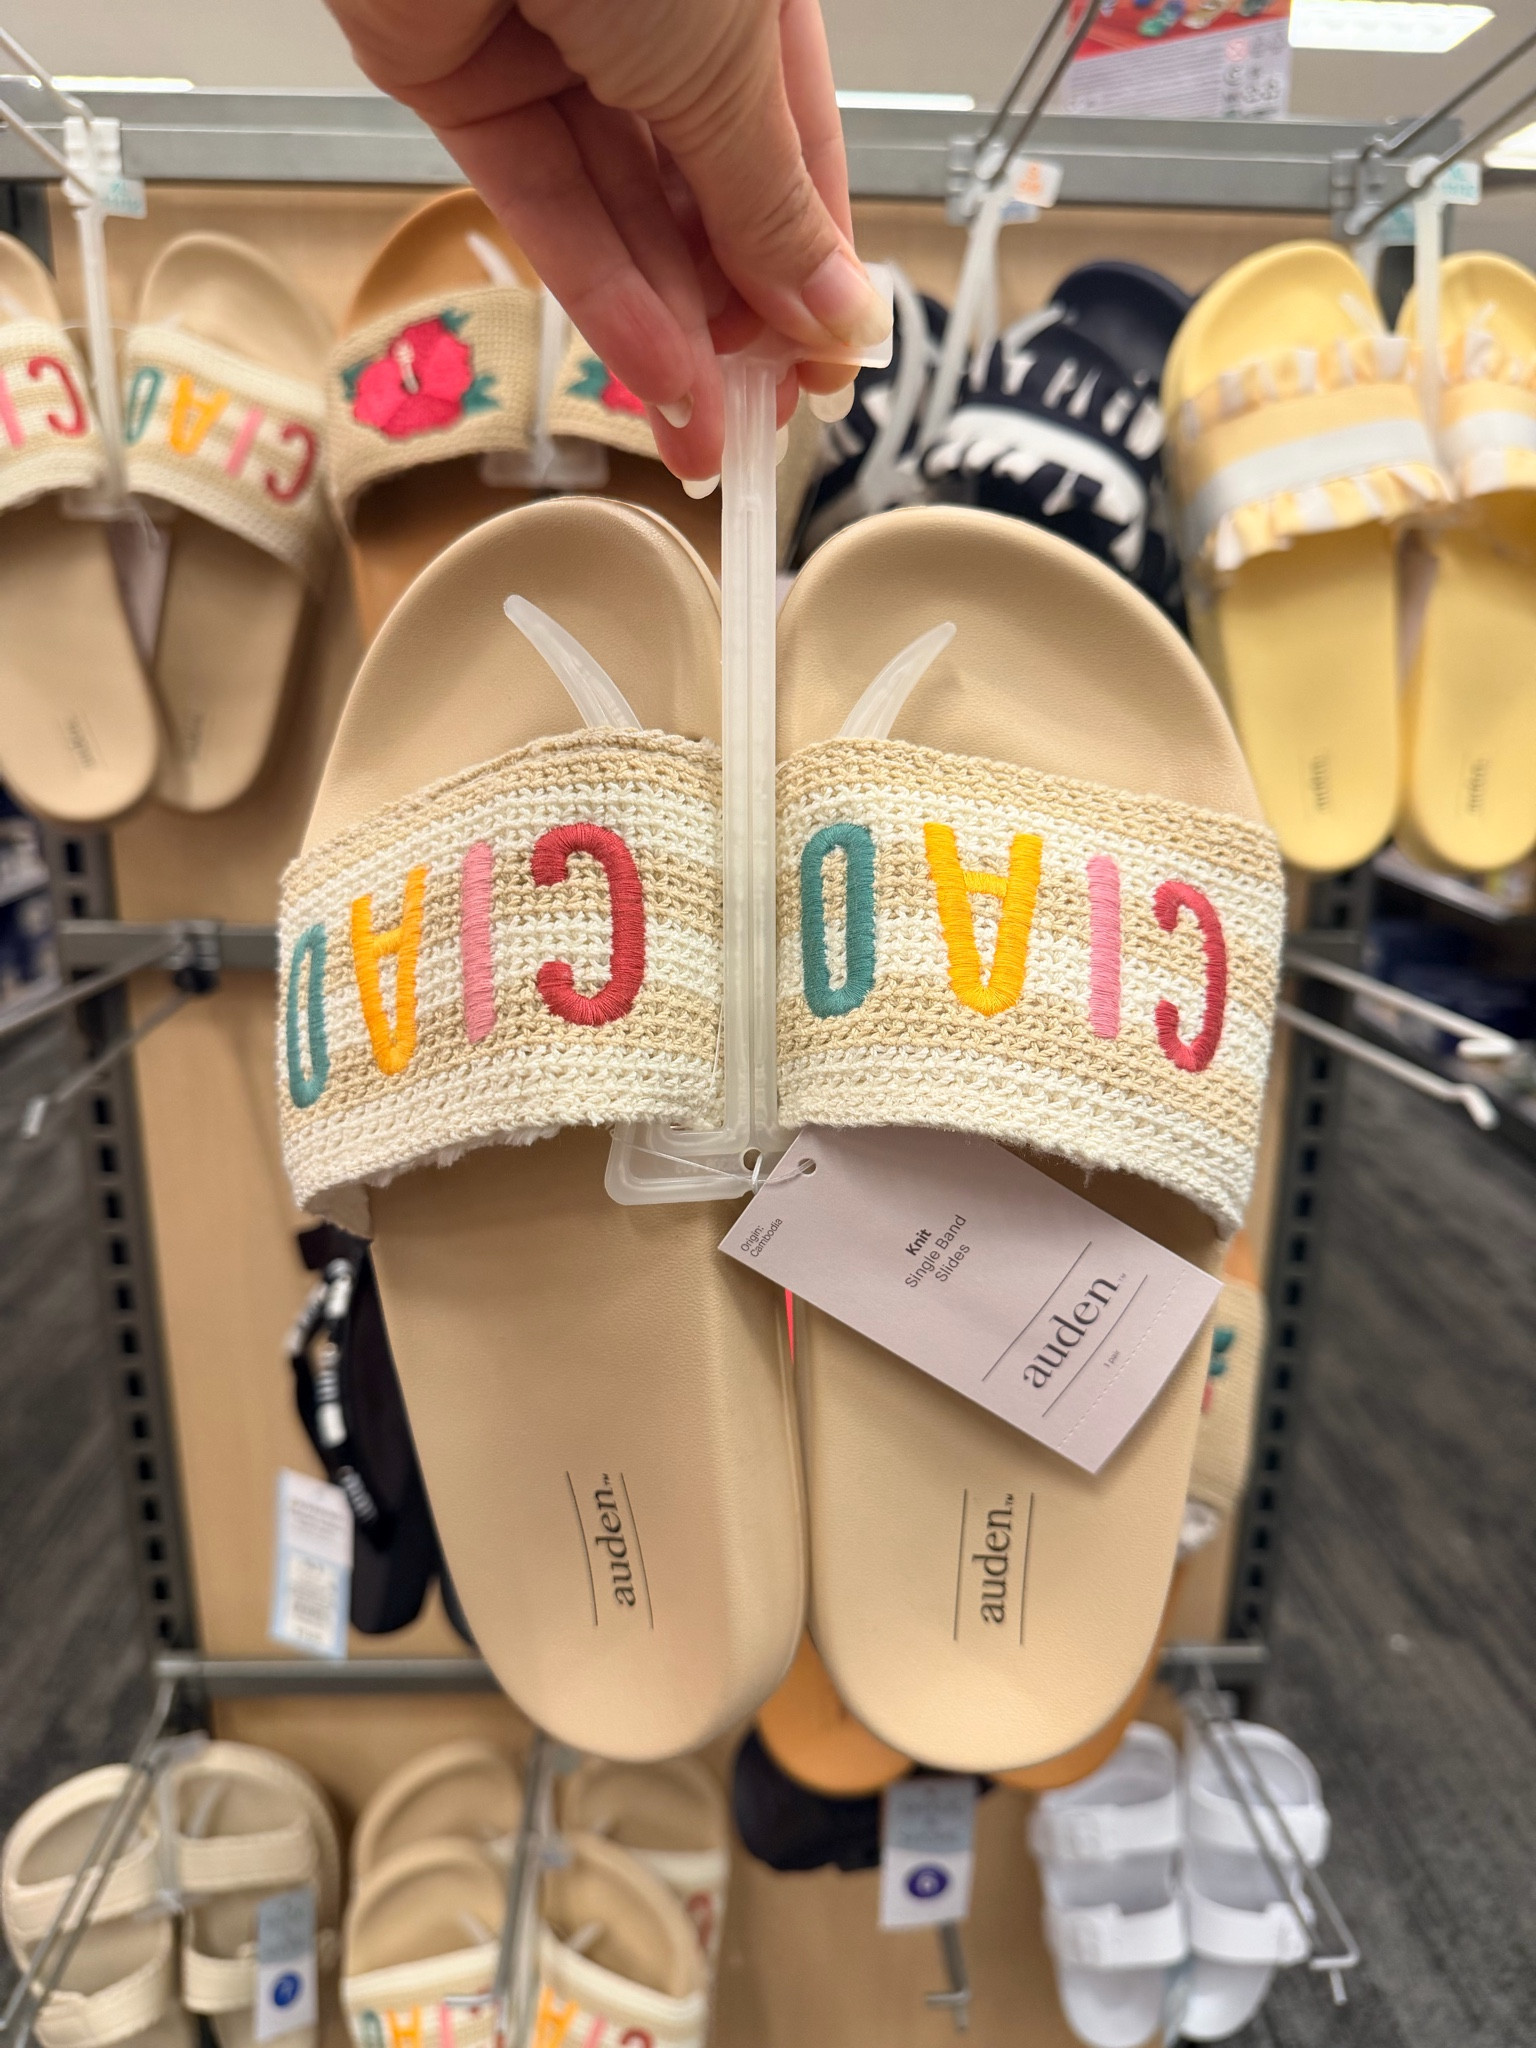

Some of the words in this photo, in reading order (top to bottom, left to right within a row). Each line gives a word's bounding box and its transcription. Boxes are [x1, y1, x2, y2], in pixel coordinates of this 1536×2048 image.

[125, 367, 320, 503] CIAO
[286, 823, 645, 1108] CIAO
[801, 822, 1227, 1072] CIAO
[740, 1225, 764, 1252] Origin:
[750, 1218, 783, 1257] Cambodia
[904, 1250, 940, 1288] Single
[935, 1214, 967, 1250] Band
[905, 1228, 932, 1256] Knit
[935, 1244, 970, 1282] Slides
